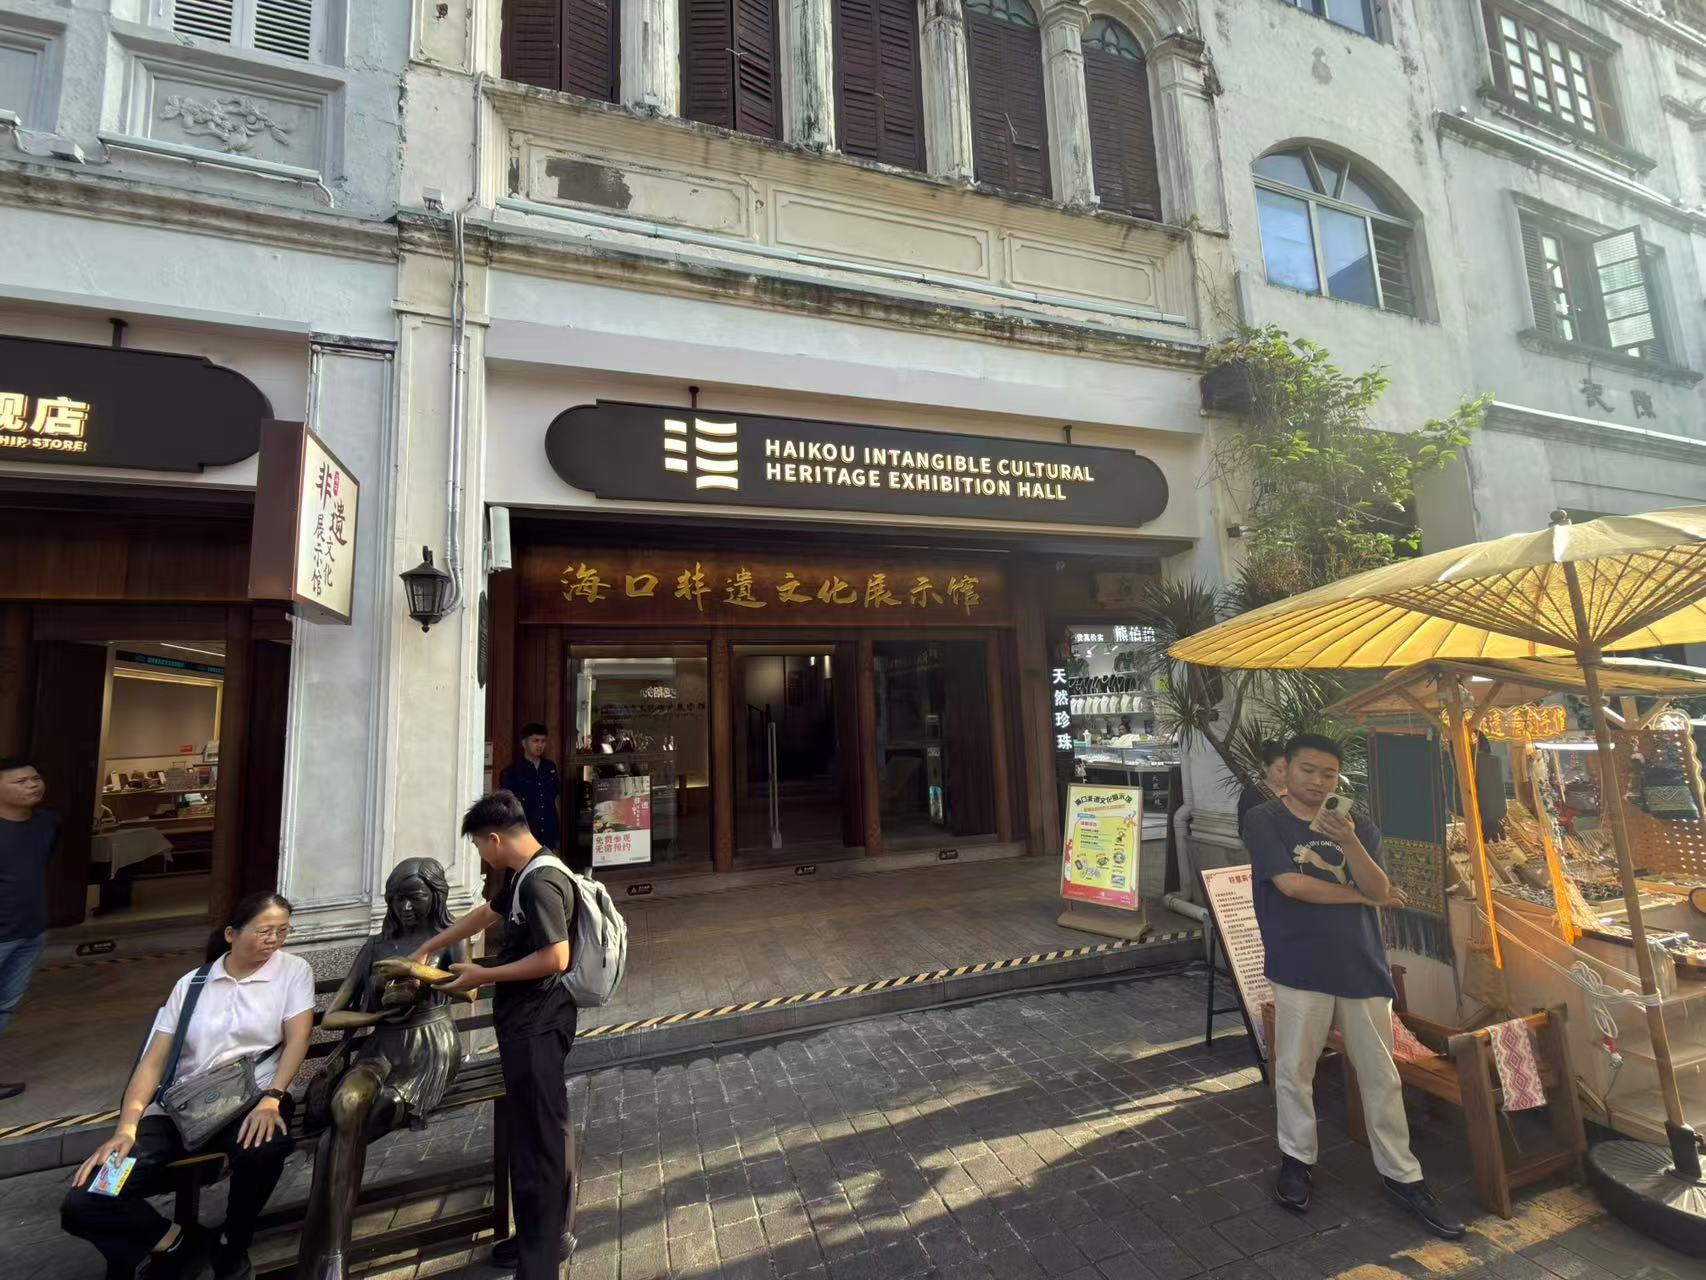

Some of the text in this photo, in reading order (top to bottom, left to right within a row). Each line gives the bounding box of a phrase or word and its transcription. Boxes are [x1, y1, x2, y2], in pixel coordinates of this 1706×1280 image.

[32, 438, 87, 452] STORE
[765, 438, 1095, 482] HAIKOU INTANGIBLE CULTURAL
[766, 462, 1067, 500] HERITAGE EXHIBITION HALL
[1052, 668, 1073, 750] 天然珍珠
